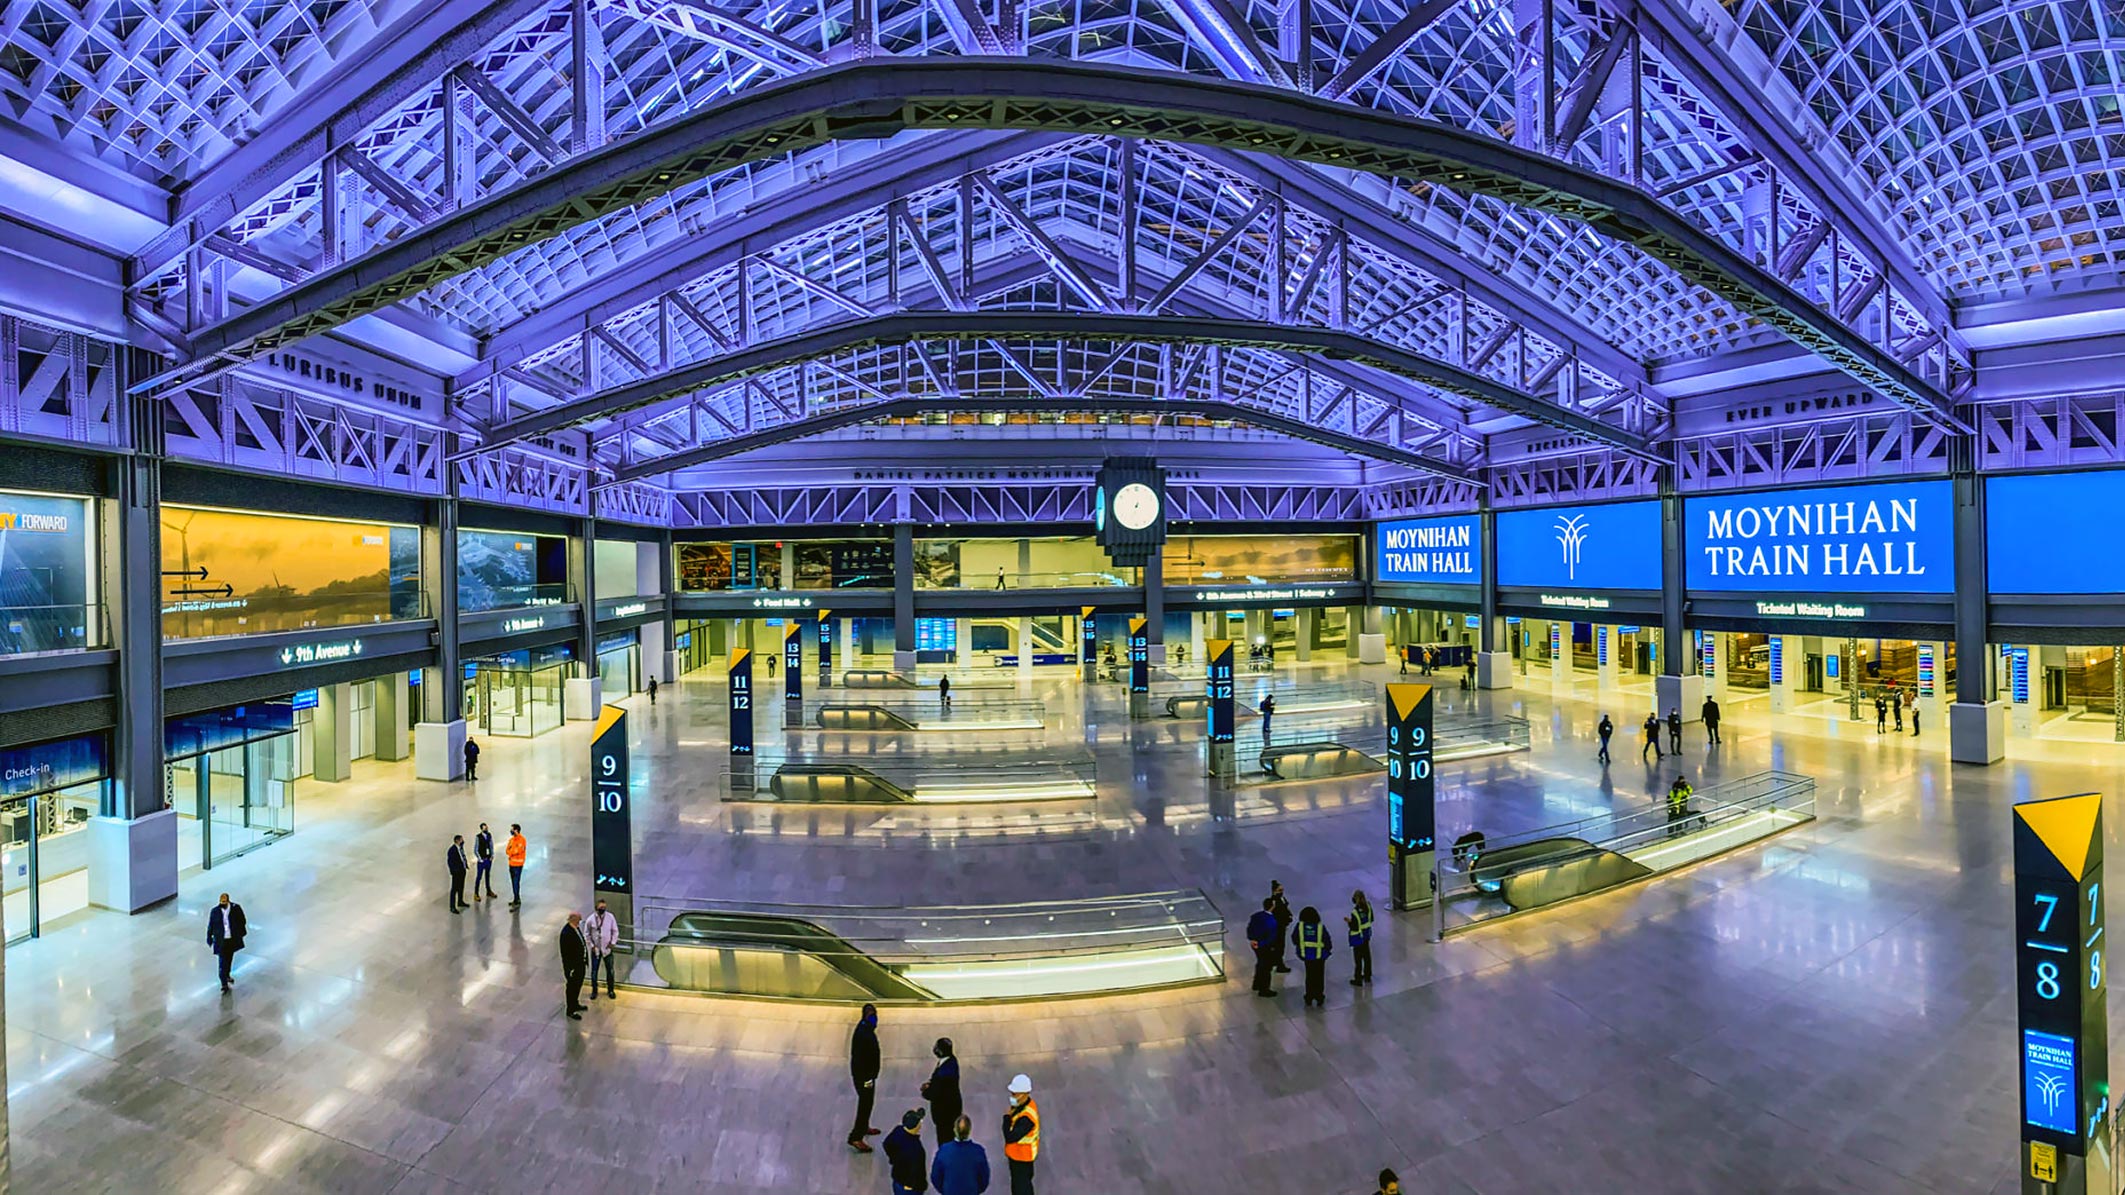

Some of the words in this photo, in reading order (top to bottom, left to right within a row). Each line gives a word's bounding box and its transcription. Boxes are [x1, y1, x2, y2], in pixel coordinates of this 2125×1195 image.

[268, 352, 364, 392] LURIBUS
[1725, 405, 1773, 423] EVER
[1784, 391, 1874, 415] UPWARD
[1527, 437, 1592, 453] EXCELSI
[21, 514, 68, 530] FORWARD
[1707, 498, 1918, 539] MOYNIHAN
[1386, 525, 1470, 549] MOYNIHAN
[1385, 553, 1428, 573] TRAIN
[1431, 552, 1473, 573] HALL
[1704, 544, 1809, 576] TRAIN
[1822, 541, 1926, 576] HALL
[1756, 602, 1795, 614] Ticketed
[1797, 603, 1834, 617] Waiting
[1834, 605, 1865, 617] Room
[787, 643, 799, 653] 13
[1135, 637, 1147, 647] 13
[295, 645, 314, 662] 9th
[314, 644, 350, 660] Avenue
[1135, 652, 1147, 661] 14
[787, 658, 799, 668] 14
[1217, 666, 1230, 678] 11
[734, 675, 747, 688] 11
[1216, 686, 1232, 699] 12
[733, 696, 749, 709] 12
[1390, 726, 1399, 746] 9
[1411, 727, 1426, 747] 9
[5, 762, 50, 780] Check-in
[602, 755, 617, 776] 9
[1389, 758, 1402, 779] 10
[1409, 759, 1431, 780] 10
[598, 791, 623, 813] 10
[2034, 894, 2059, 932] 7
[2090, 950, 2101, 990] 8
[2036, 961, 2060, 1000] 8
[2028, 1043, 2072, 1058] MOYNIHAN
[2028, 1050, 2052, 1061] TRAIN
[2052, 1055, 2073, 1066] HALL
